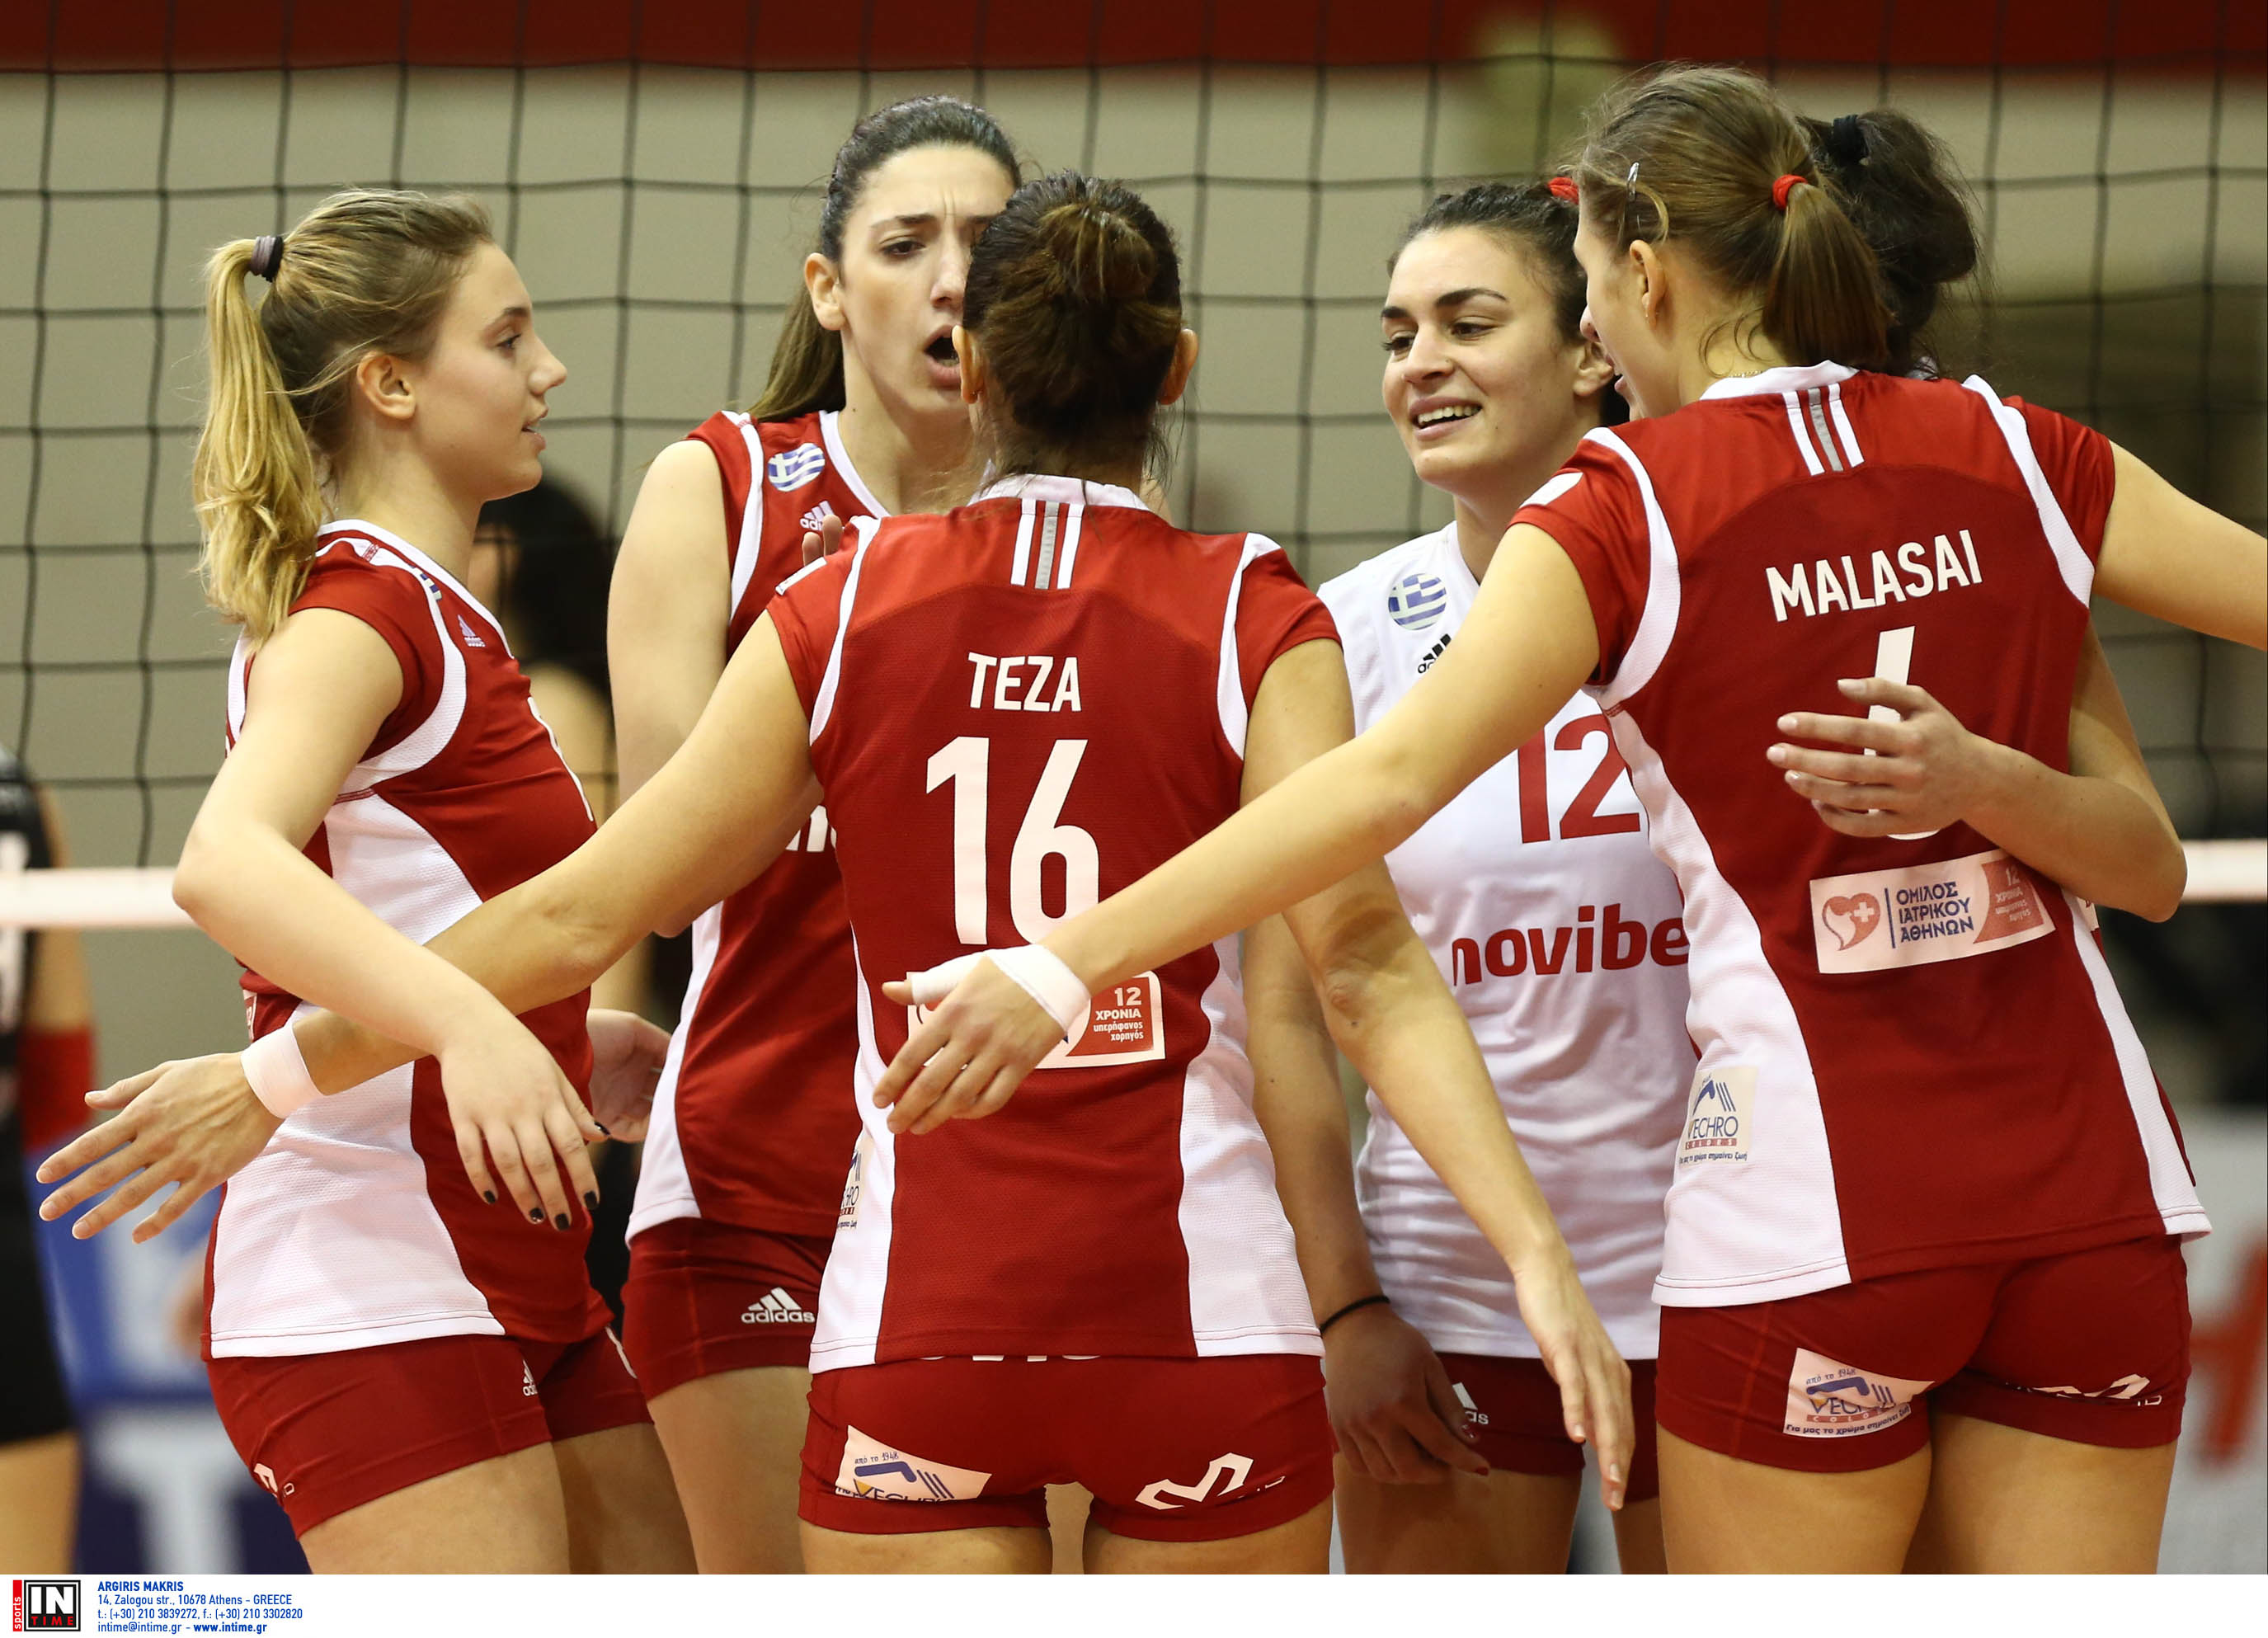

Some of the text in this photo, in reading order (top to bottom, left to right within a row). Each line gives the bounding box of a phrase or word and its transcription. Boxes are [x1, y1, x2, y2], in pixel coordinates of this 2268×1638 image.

[1765, 529, 1983, 623] MALASAI
[967, 652, 1082, 713] TEZA
[1517, 713, 1641, 845] 12
[925, 736, 1100, 946] 16
[1896, 881, 1958, 906] ΟΜΙΛΟΣ
[1899, 897, 1971, 925] ΙΑΤΡΙΚΟΥ
[1899, 916, 1974, 944] ΑΘΗΝΩΝ
[1114, 986, 1142, 1007] 12
[1095, 1008, 1142, 1021] ΧΡΟΝΙΑ
[741, 1308, 816, 1324] adidas
